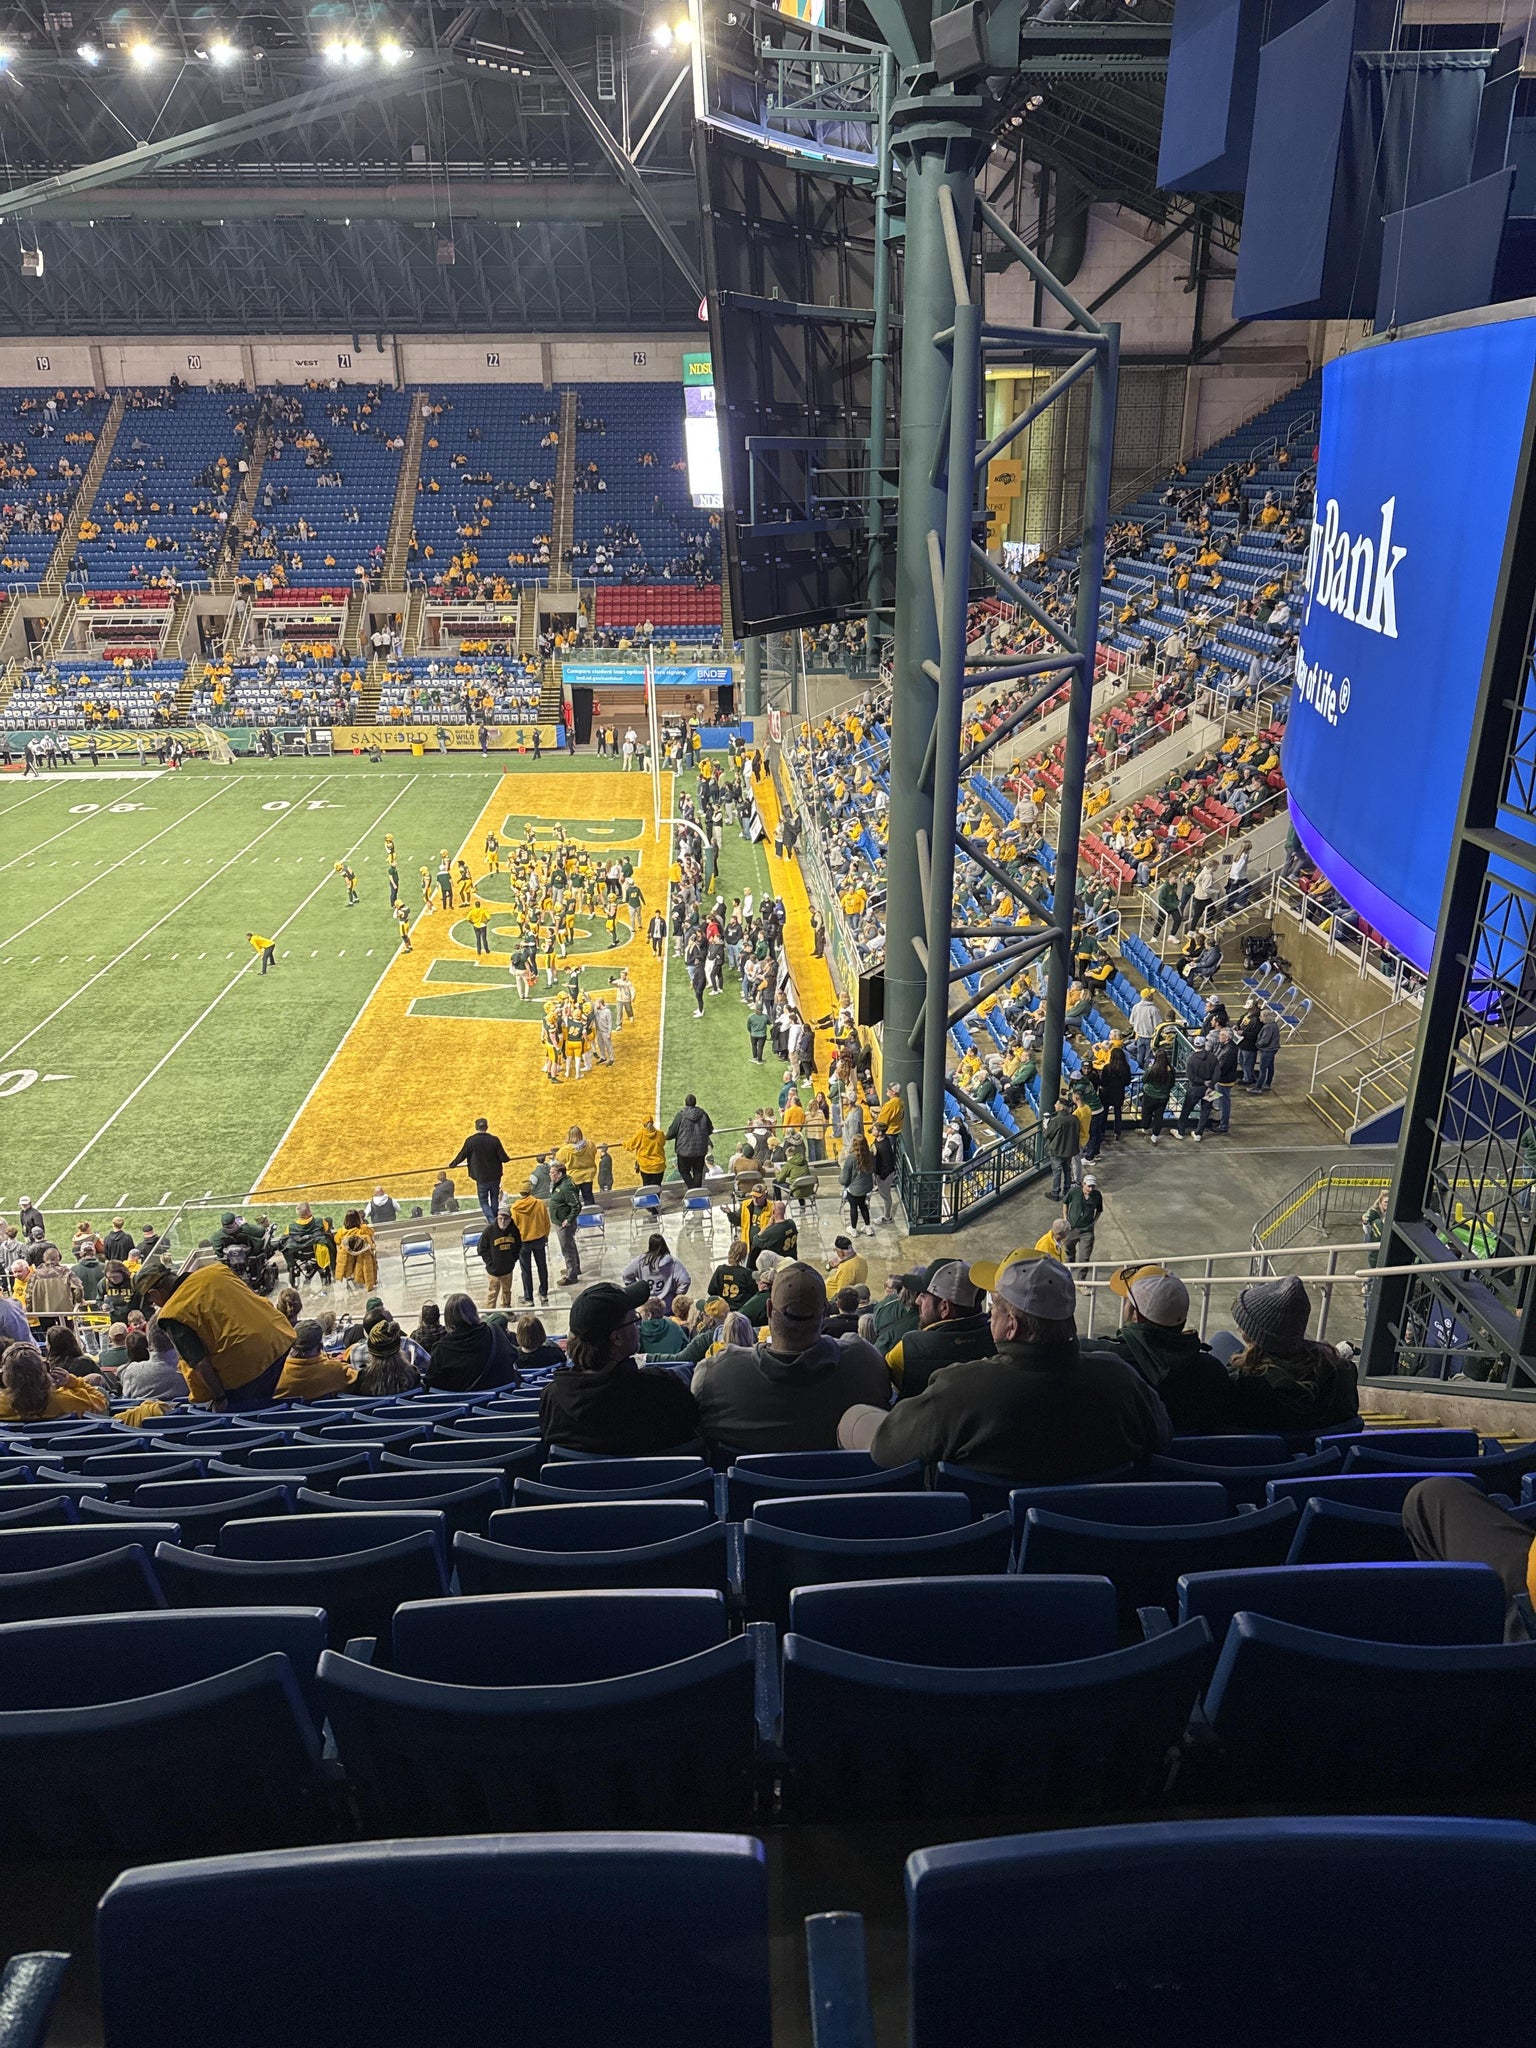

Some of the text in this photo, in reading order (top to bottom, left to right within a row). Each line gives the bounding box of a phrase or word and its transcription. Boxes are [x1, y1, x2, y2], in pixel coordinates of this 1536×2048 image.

[37, 357, 49, 370] 19
[188, 356, 200, 369] 20
[339, 355, 351, 368] 21
[487, 353, 499, 366] 22
[634, 353, 645, 365] 23
[1316, 495, 1407, 639] Bank
[697, 669, 718, 678] BND
[351, 732, 429, 743] SANFORD
